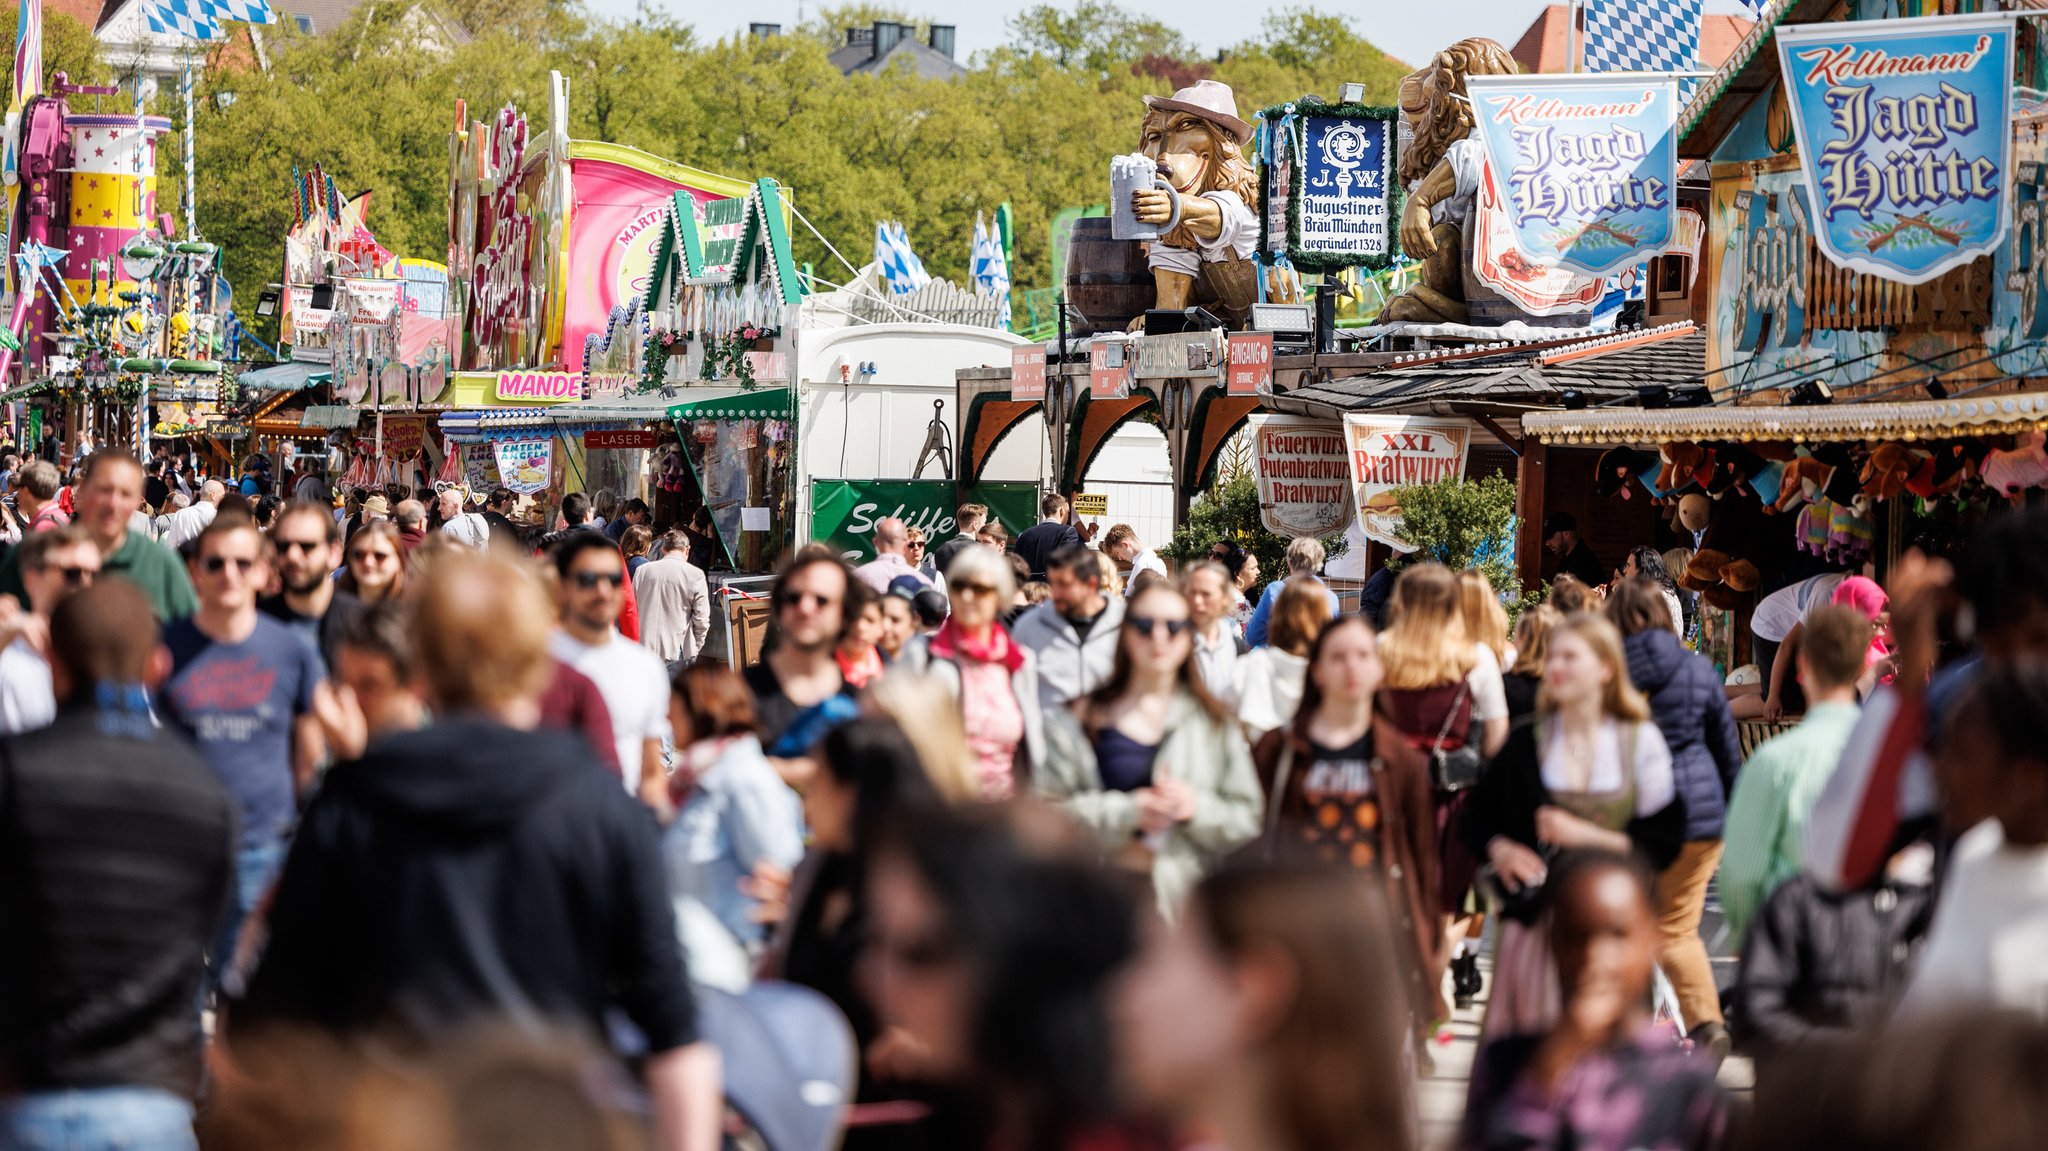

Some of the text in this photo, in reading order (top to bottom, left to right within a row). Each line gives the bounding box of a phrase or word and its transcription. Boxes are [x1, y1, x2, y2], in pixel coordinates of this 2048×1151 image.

[1823, 81, 1978, 153] Jagd
[1510, 123, 1648, 174] Jagd
[1818, 148, 2000, 222] Hütte
[1508, 170, 1670, 228] Hütte
[1304, 215, 1382, 234] Bräu München
[1304, 238, 1382, 251] gegründet 1328
[301, 312, 323, 320] Freie
[358, 308, 381, 317] Freie
[1231, 342, 1260, 364] EINGANG
[601, 435, 641, 445] LASER
[1382, 434, 1435, 452] XXL
[1353, 450, 1463, 485] Bratwurst
[1272, 482, 1344, 504] Bratwurst
